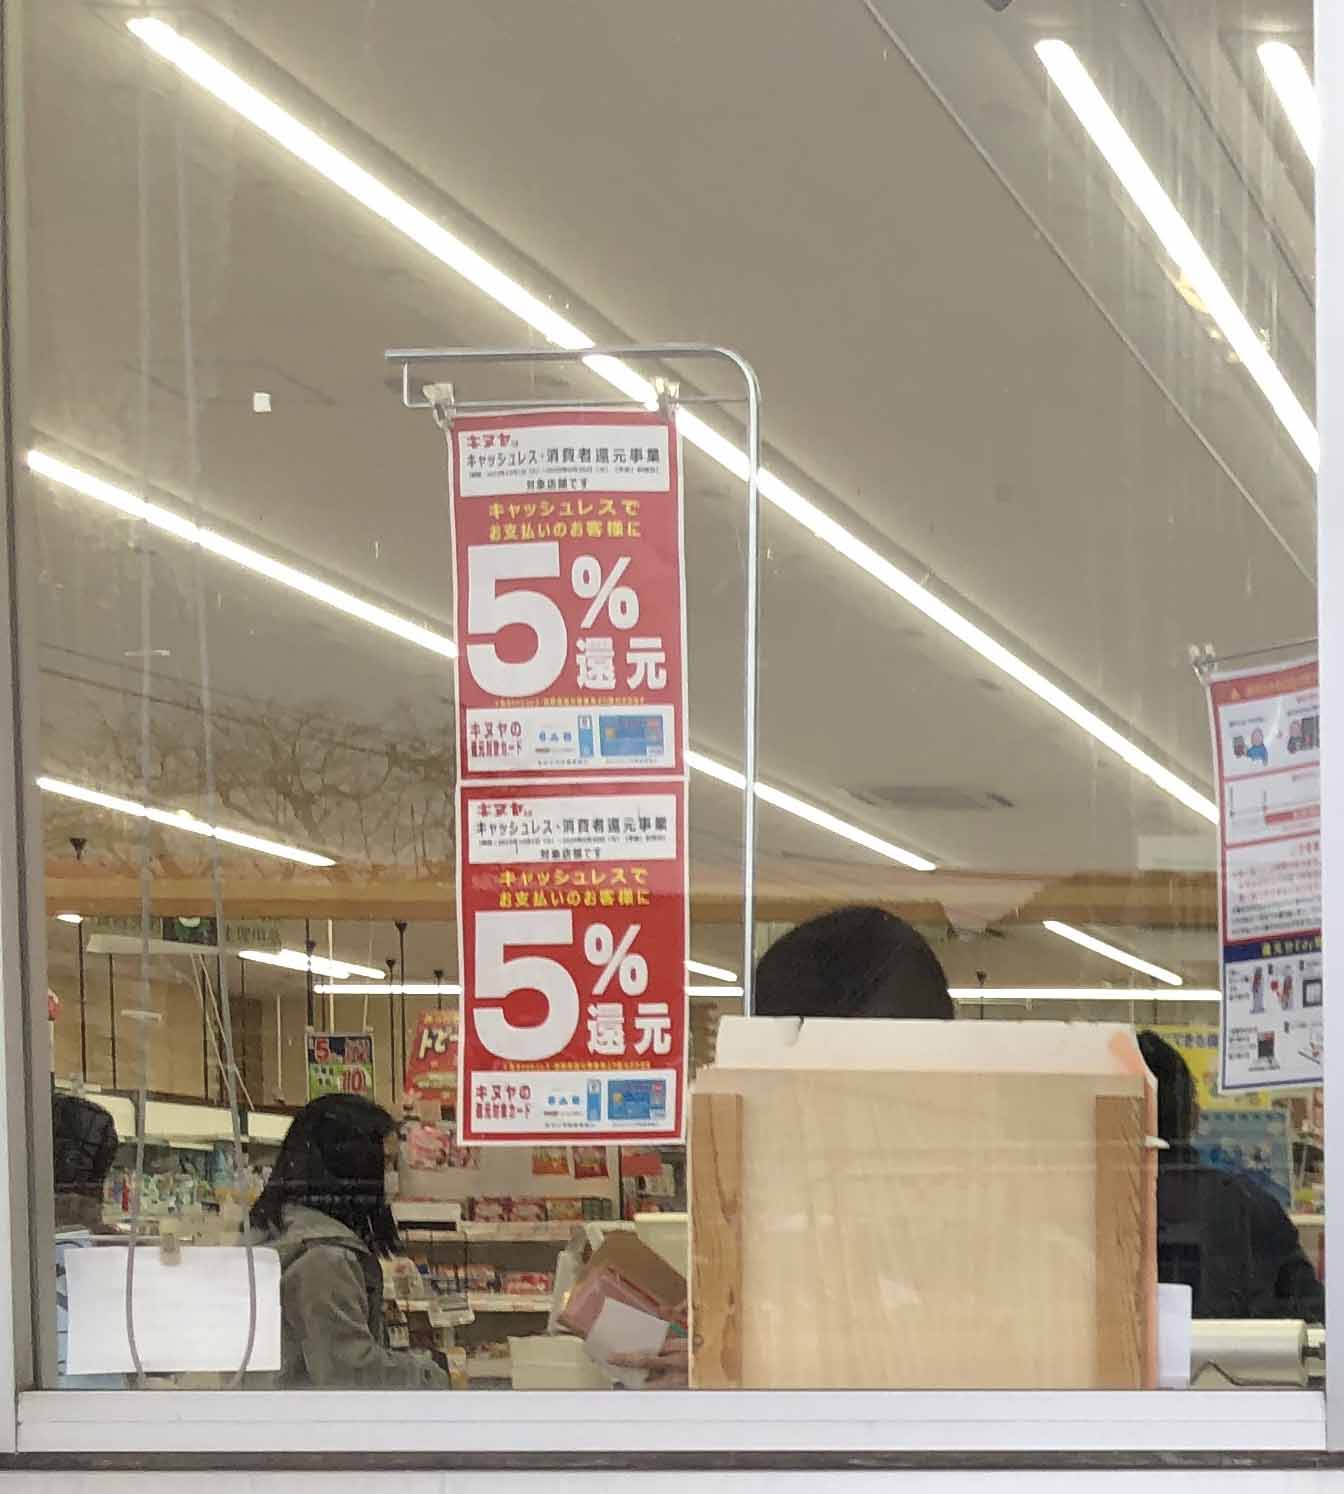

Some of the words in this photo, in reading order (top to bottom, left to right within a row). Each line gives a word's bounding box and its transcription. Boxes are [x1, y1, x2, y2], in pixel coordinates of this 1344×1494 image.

[488, 499, 641, 519] キャッシュレスで
[489, 520, 641, 541] お支払いのお客様に
[576, 636, 667, 690] 還元
[499, 868, 648, 888] キャッシュレスで
[499, 890, 650, 907] お支払いのお客様に
[588, 1003, 671, 1056] 還元
